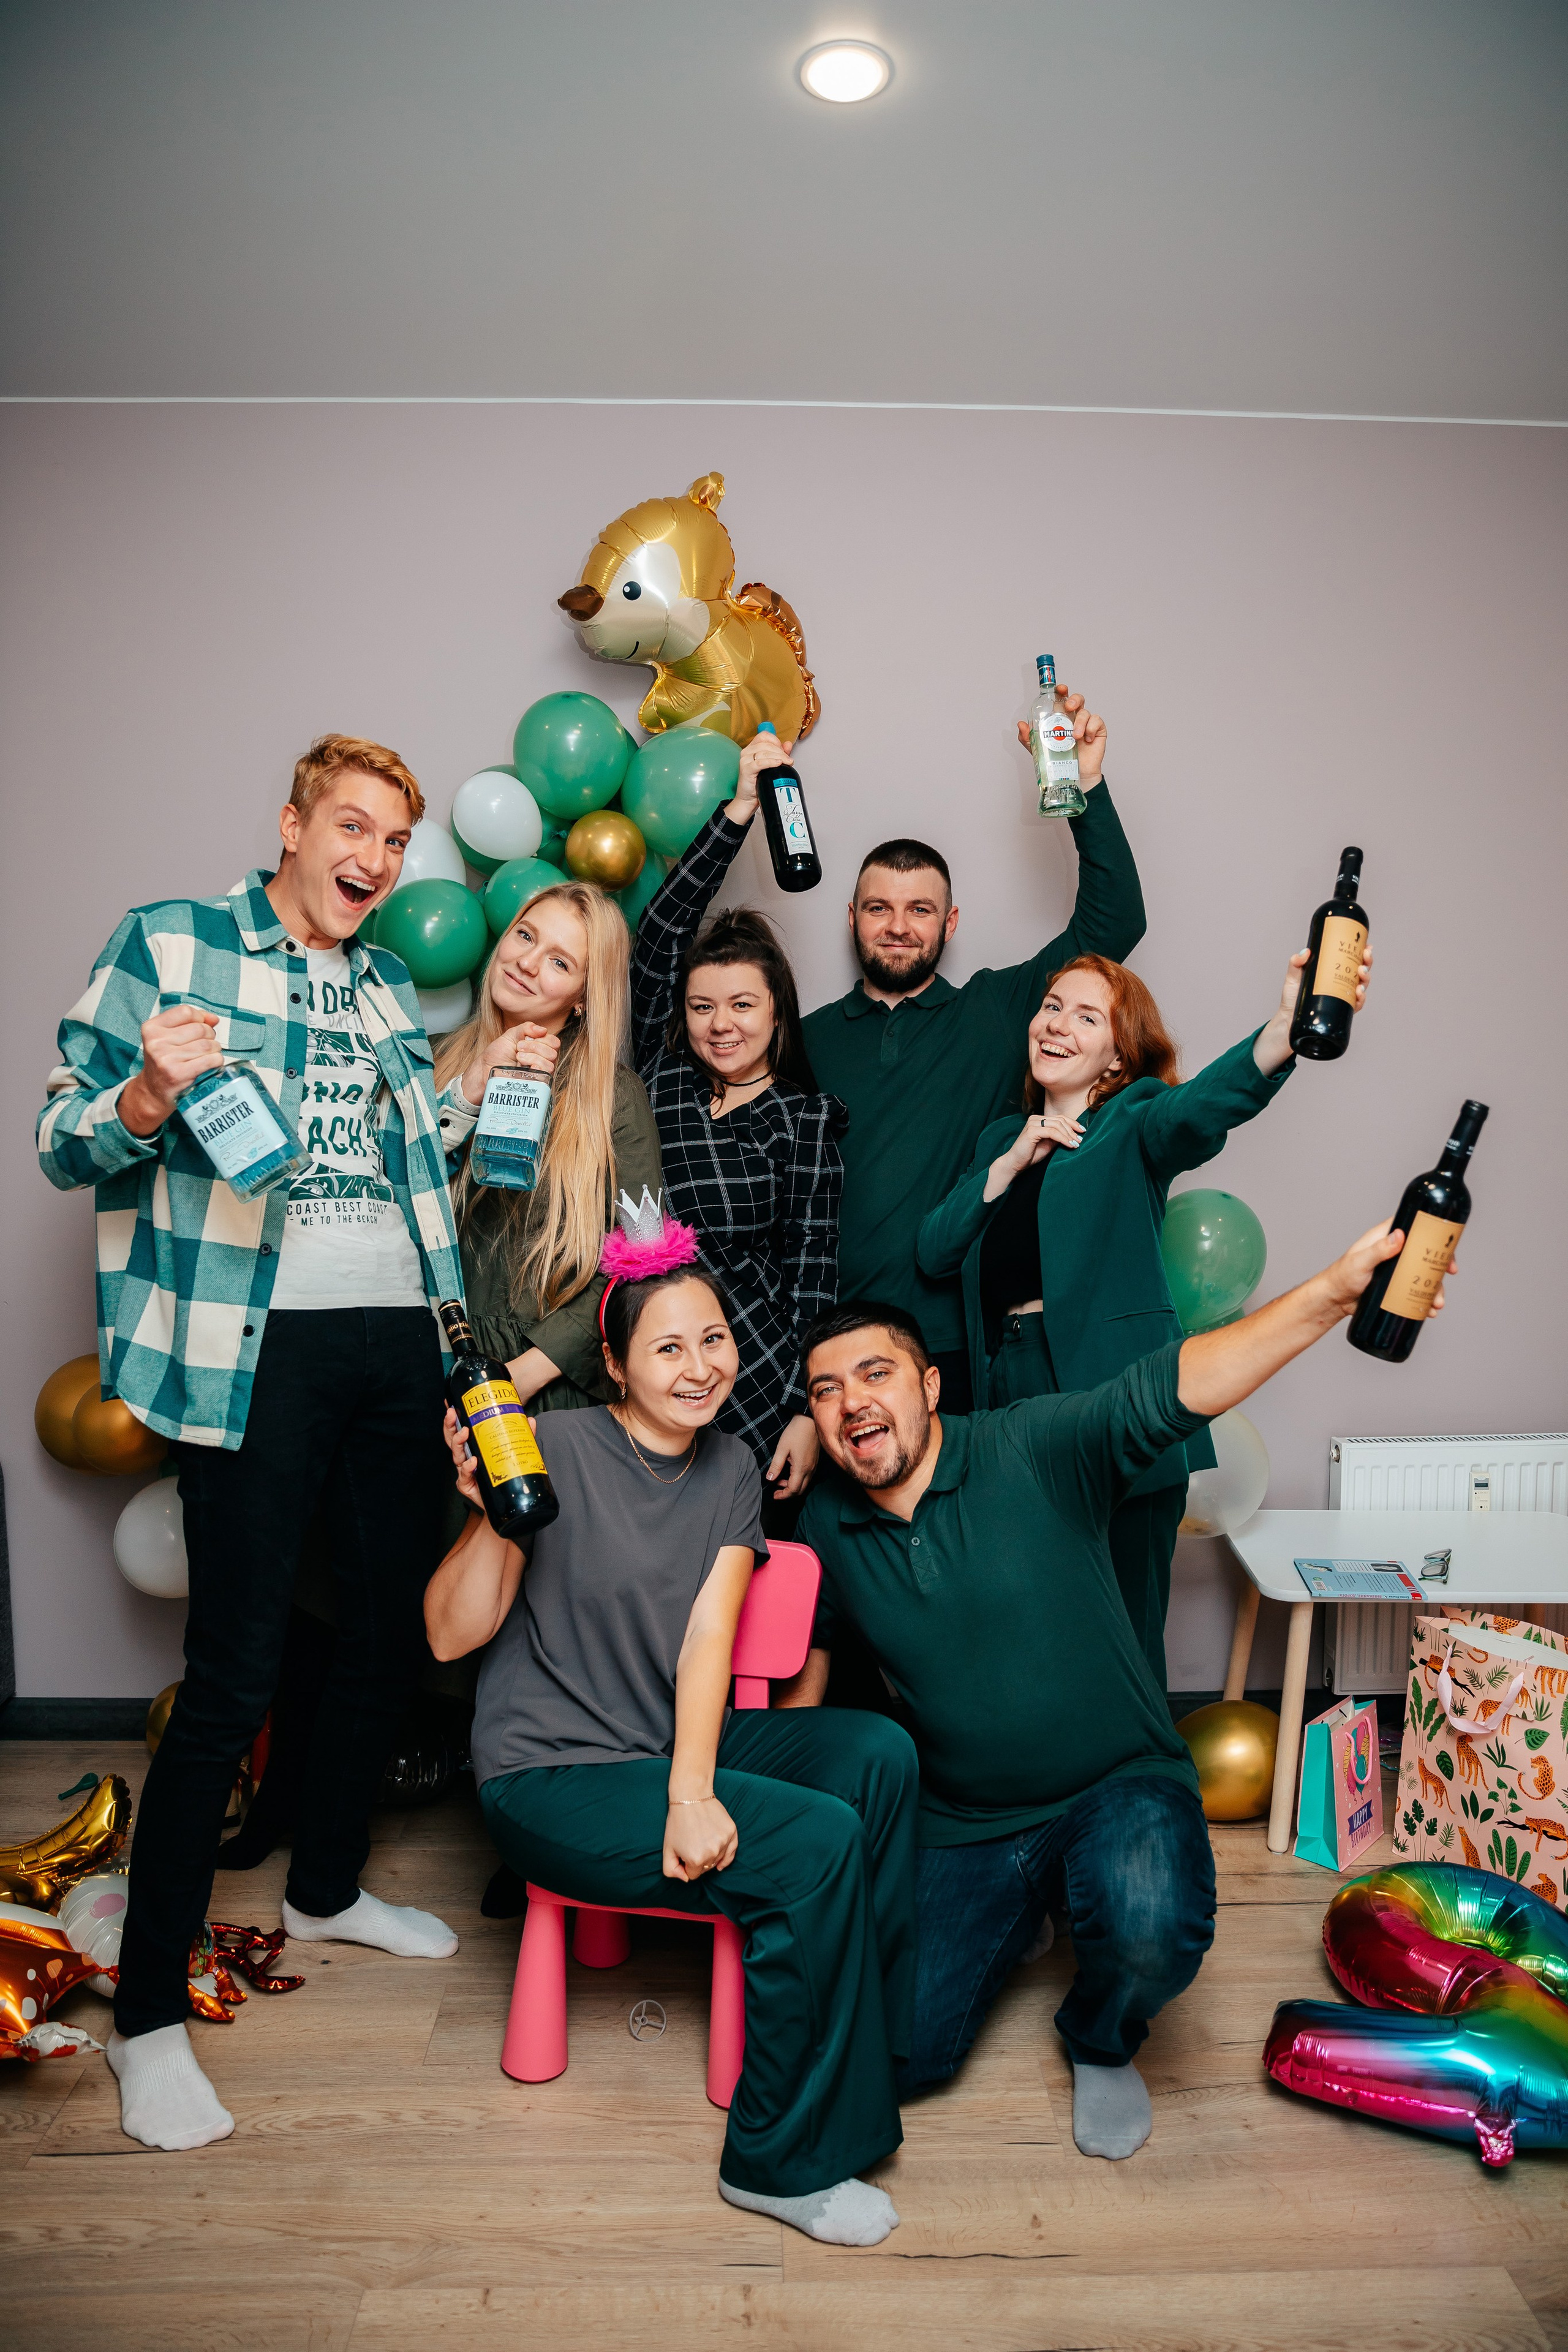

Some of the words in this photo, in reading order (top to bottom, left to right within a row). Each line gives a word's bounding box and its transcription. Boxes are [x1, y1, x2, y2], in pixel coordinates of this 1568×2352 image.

[780, 788, 796, 803] T
[790, 822, 806, 839] C
[488, 1092, 540, 1109] BARRISTER
[197, 1101, 255, 1144] BARRISTER
[213, 1130, 235, 1147] BLUE
[235, 1118, 252, 1133] GIN
[298, 1116, 368, 1158] ACH
[287, 1202, 326, 1216] COAST
[334, 1202, 361, 1213] BEST
[368, 1202, 388, 1215] COAST
[301, 1216, 314, 1226] ME
[320, 1215, 331, 1224] TO
[337, 1215, 352, 1224] THE
[356, 1215, 378, 1224] BEACH
[468, 1389, 518, 1408] ELEGIDO
[472, 1407, 504, 1423] MEDIUM
[1352, 1805, 1368, 1830] HAPPY
[1351, 1820, 1371, 1849] BIRTHDAY
